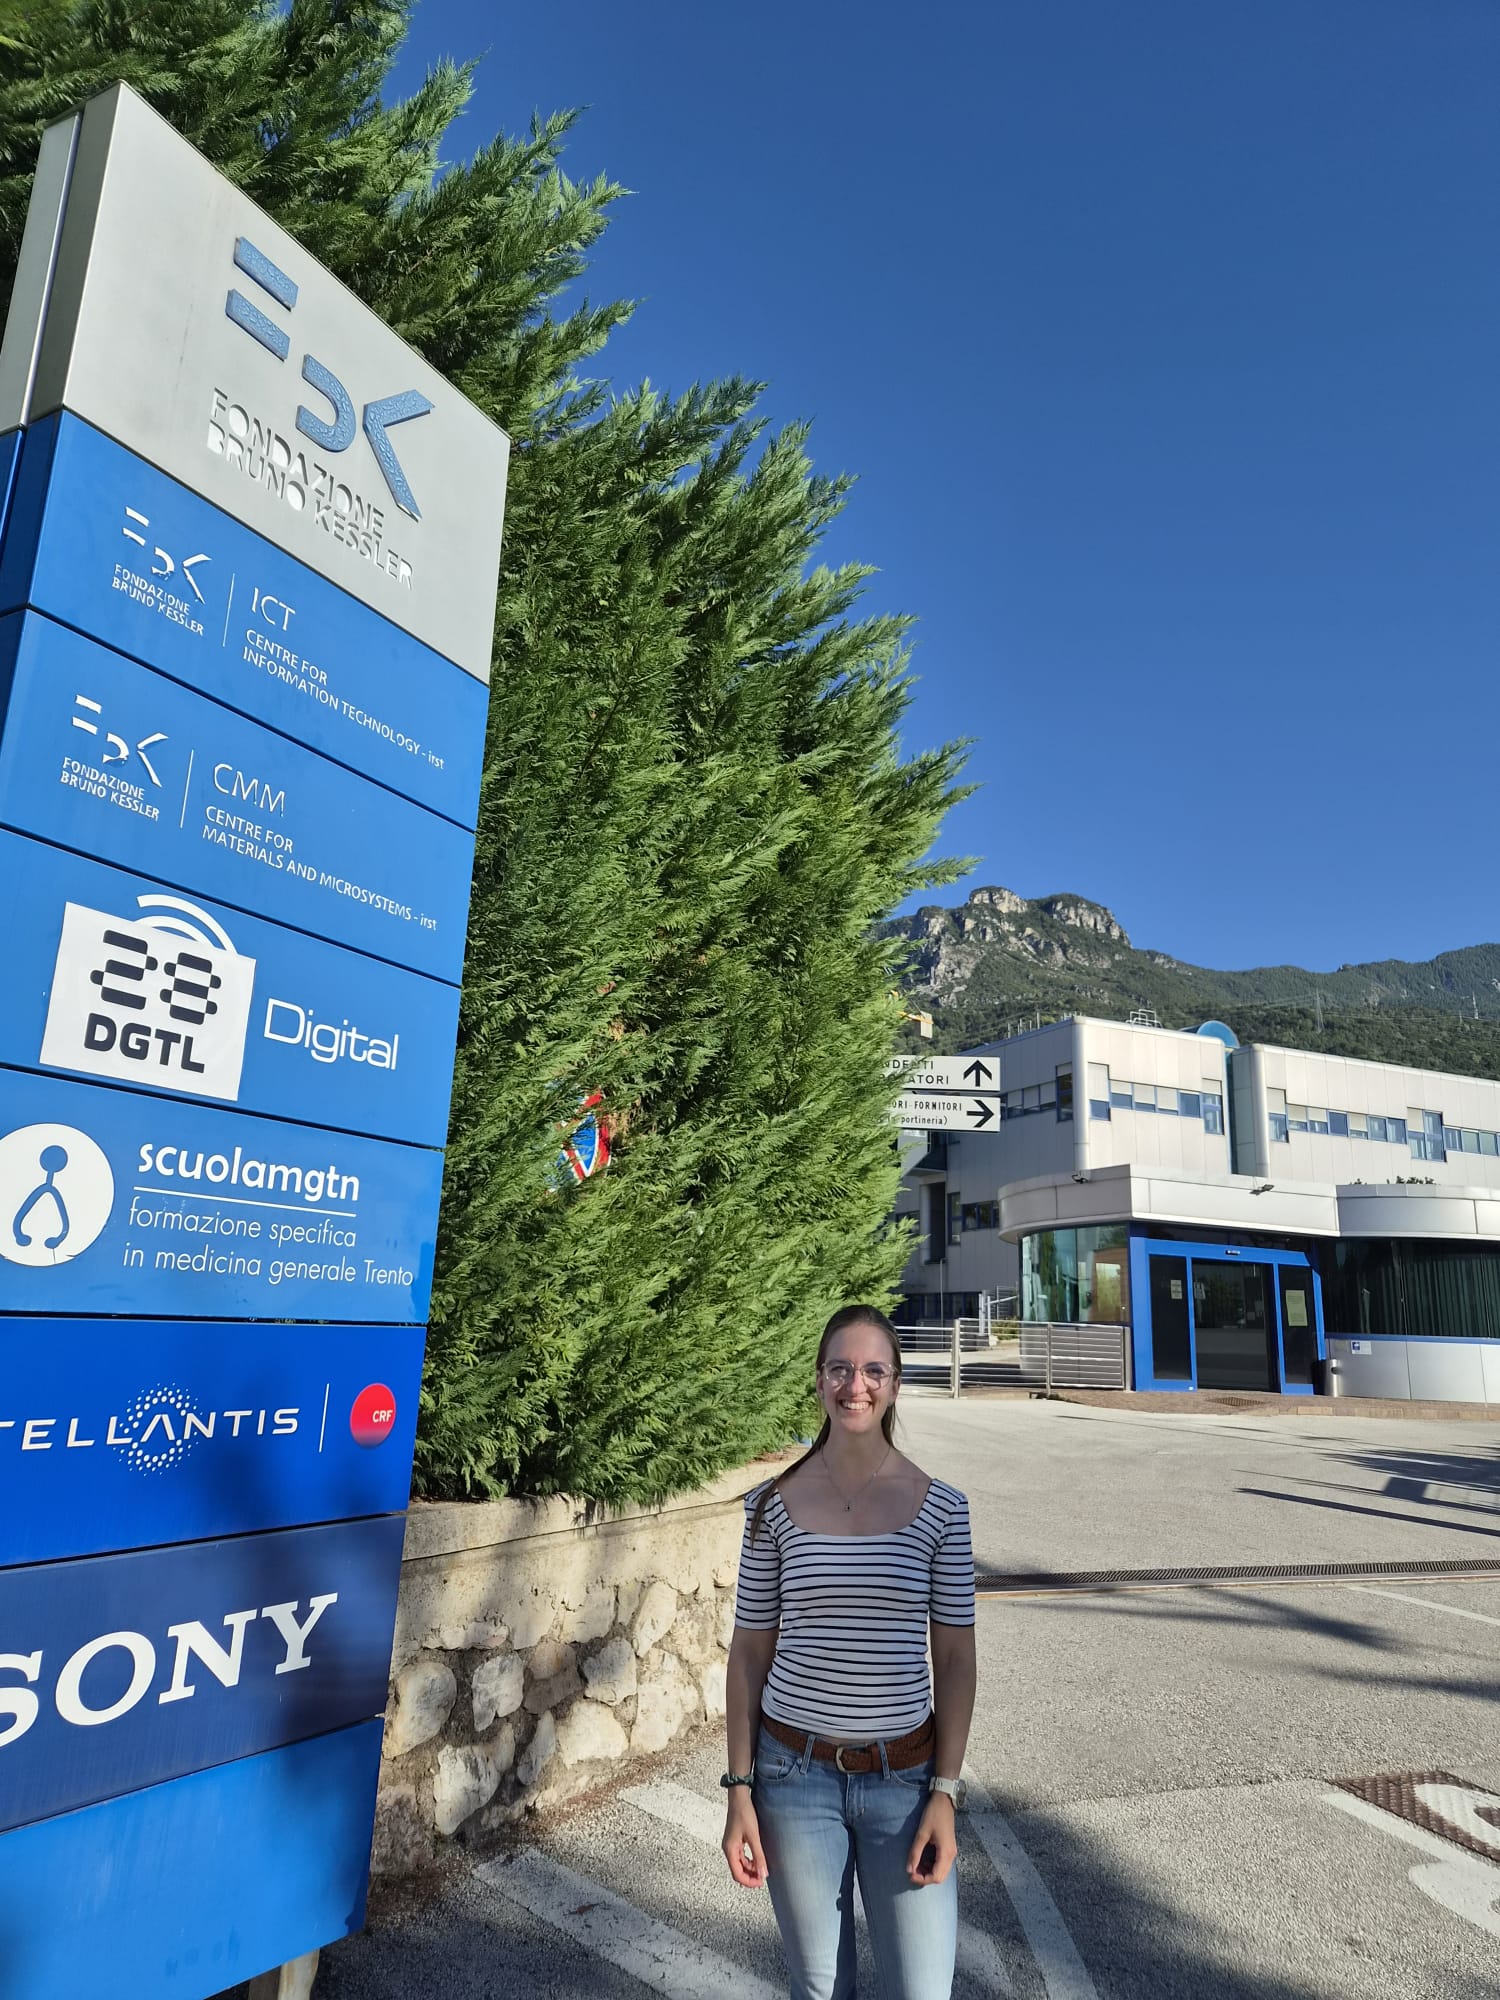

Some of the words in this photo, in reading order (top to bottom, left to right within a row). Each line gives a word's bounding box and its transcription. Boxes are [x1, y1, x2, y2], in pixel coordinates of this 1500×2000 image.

[211, 387, 384, 540] FONDAZIONE
[207, 419, 306, 511] BRUNO
[315, 499, 413, 590] KESSLER
[112, 576, 154, 607] BRUNO
[157, 602, 204, 636] KESSLER
[114, 563, 190, 616] FONDAZIONE
[251, 587, 296, 631] ICT
[246, 629, 298, 669] CENTRE
[301, 660, 328, 685] FOR
[243, 646, 339, 710] INFORMATION
[341, 700, 421, 755] TECHNOLOGY
[428, 751, 444, 769] irst
[60, 771, 107, 798] BRUNO
[110, 791, 160, 821] KESSLER
[63, 757, 146, 801] FONDAZIONE
[213, 763, 285, 817] CMM
[205, 806, 262, 841] CENTRE
[265, 829, 293, 853] FOR
[202, 825, 284, 869] MATERIALS
[286, 860, 317, 881] AND
[319, 872, 412, 921] MICROSYSTEMS
[420, 913, 437, 931] irst
[84, 1012, 205, 1074] DGTL
[264, 997, 399, 1070] Digital
[138, 1143, 360, 1202] scuolamgtn
[129, 1196, 261, 1240] formazione
[269, 1219, 356, 1249] specifica
[123, 1242, 144, 1267] in
[155, 1245, 261, 1275] medicina
[269, 1257, 356, 1286] generale
[364, 1260, 413, 1287] Trento
[372, 1409, 393, 1423] CRF
